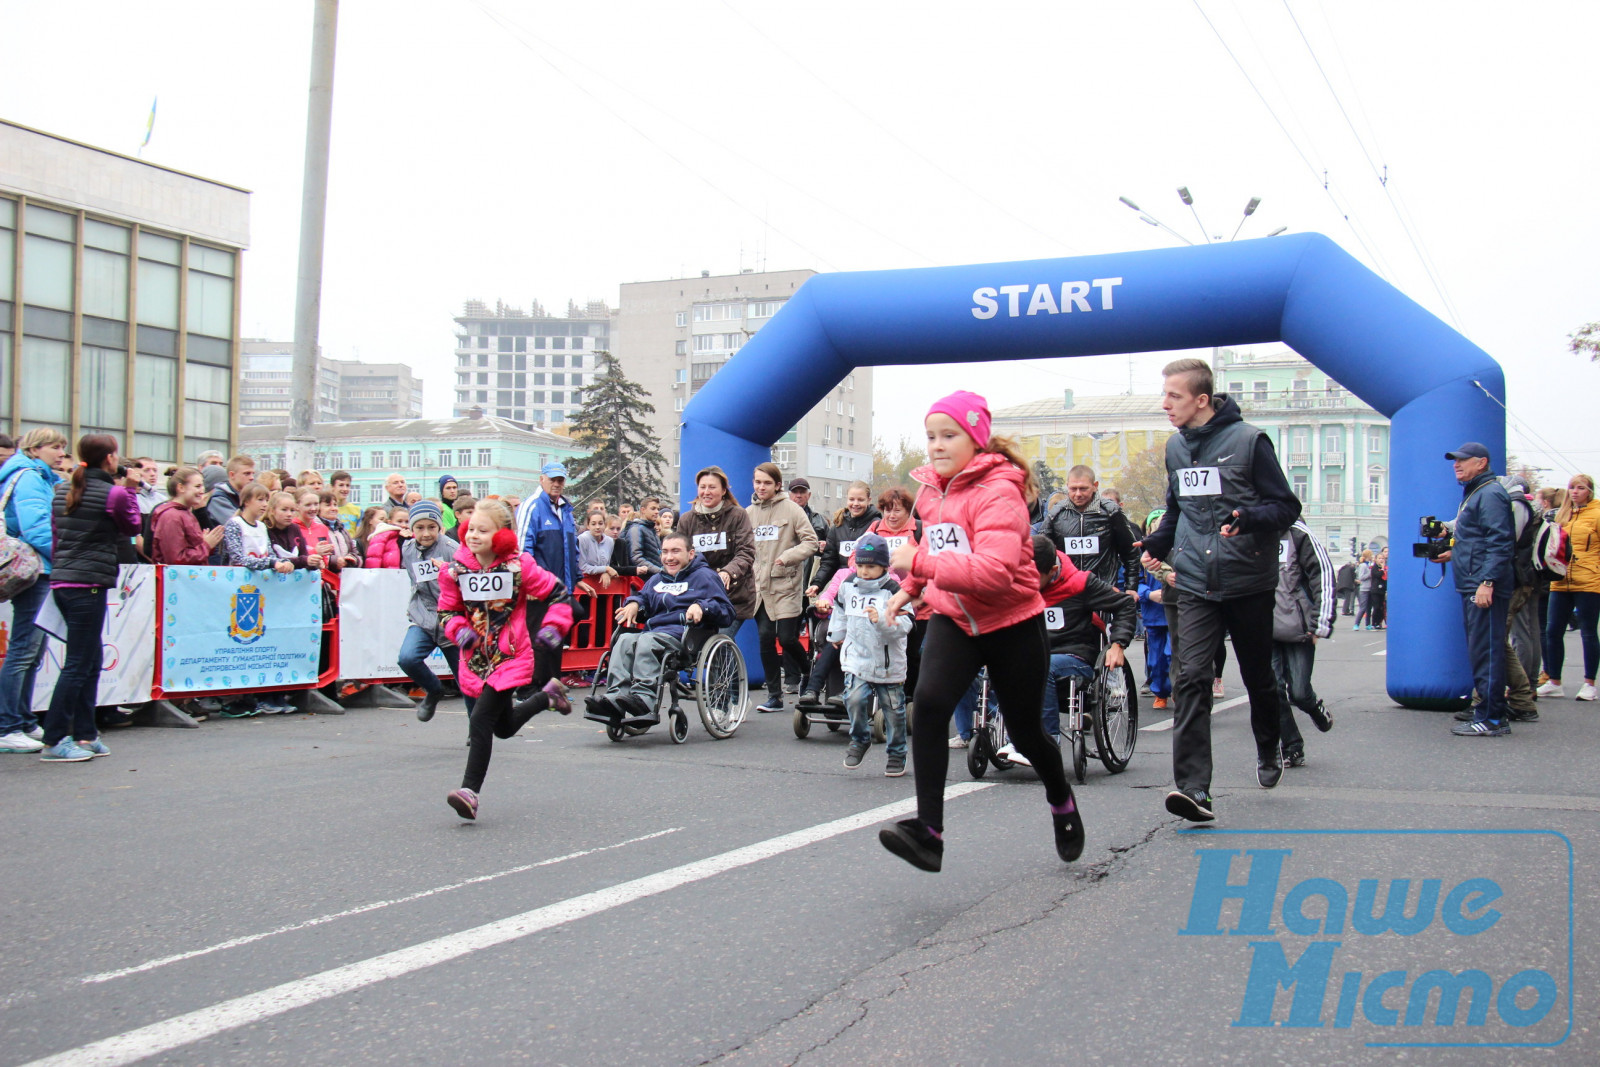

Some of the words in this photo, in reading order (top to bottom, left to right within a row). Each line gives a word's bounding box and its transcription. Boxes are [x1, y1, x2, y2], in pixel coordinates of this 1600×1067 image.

[971, 277, 1123, 320] START
[1184, 470, 1210, 487] 607
[756, 527, 774, 537] 622
[929, 527, 960, 551] 634
[888, 538, 902, 548] 19
[1070, 538, 1093, 550] 613
[418, 562, 439, 576] 625
[468, 575, 503, 592] 620
[851, 595, 877, 609] 615
[180, 656, 230, 665] ДЕПАРТАМЕНТУ
[273, 661, 289, 669] РАДИ
